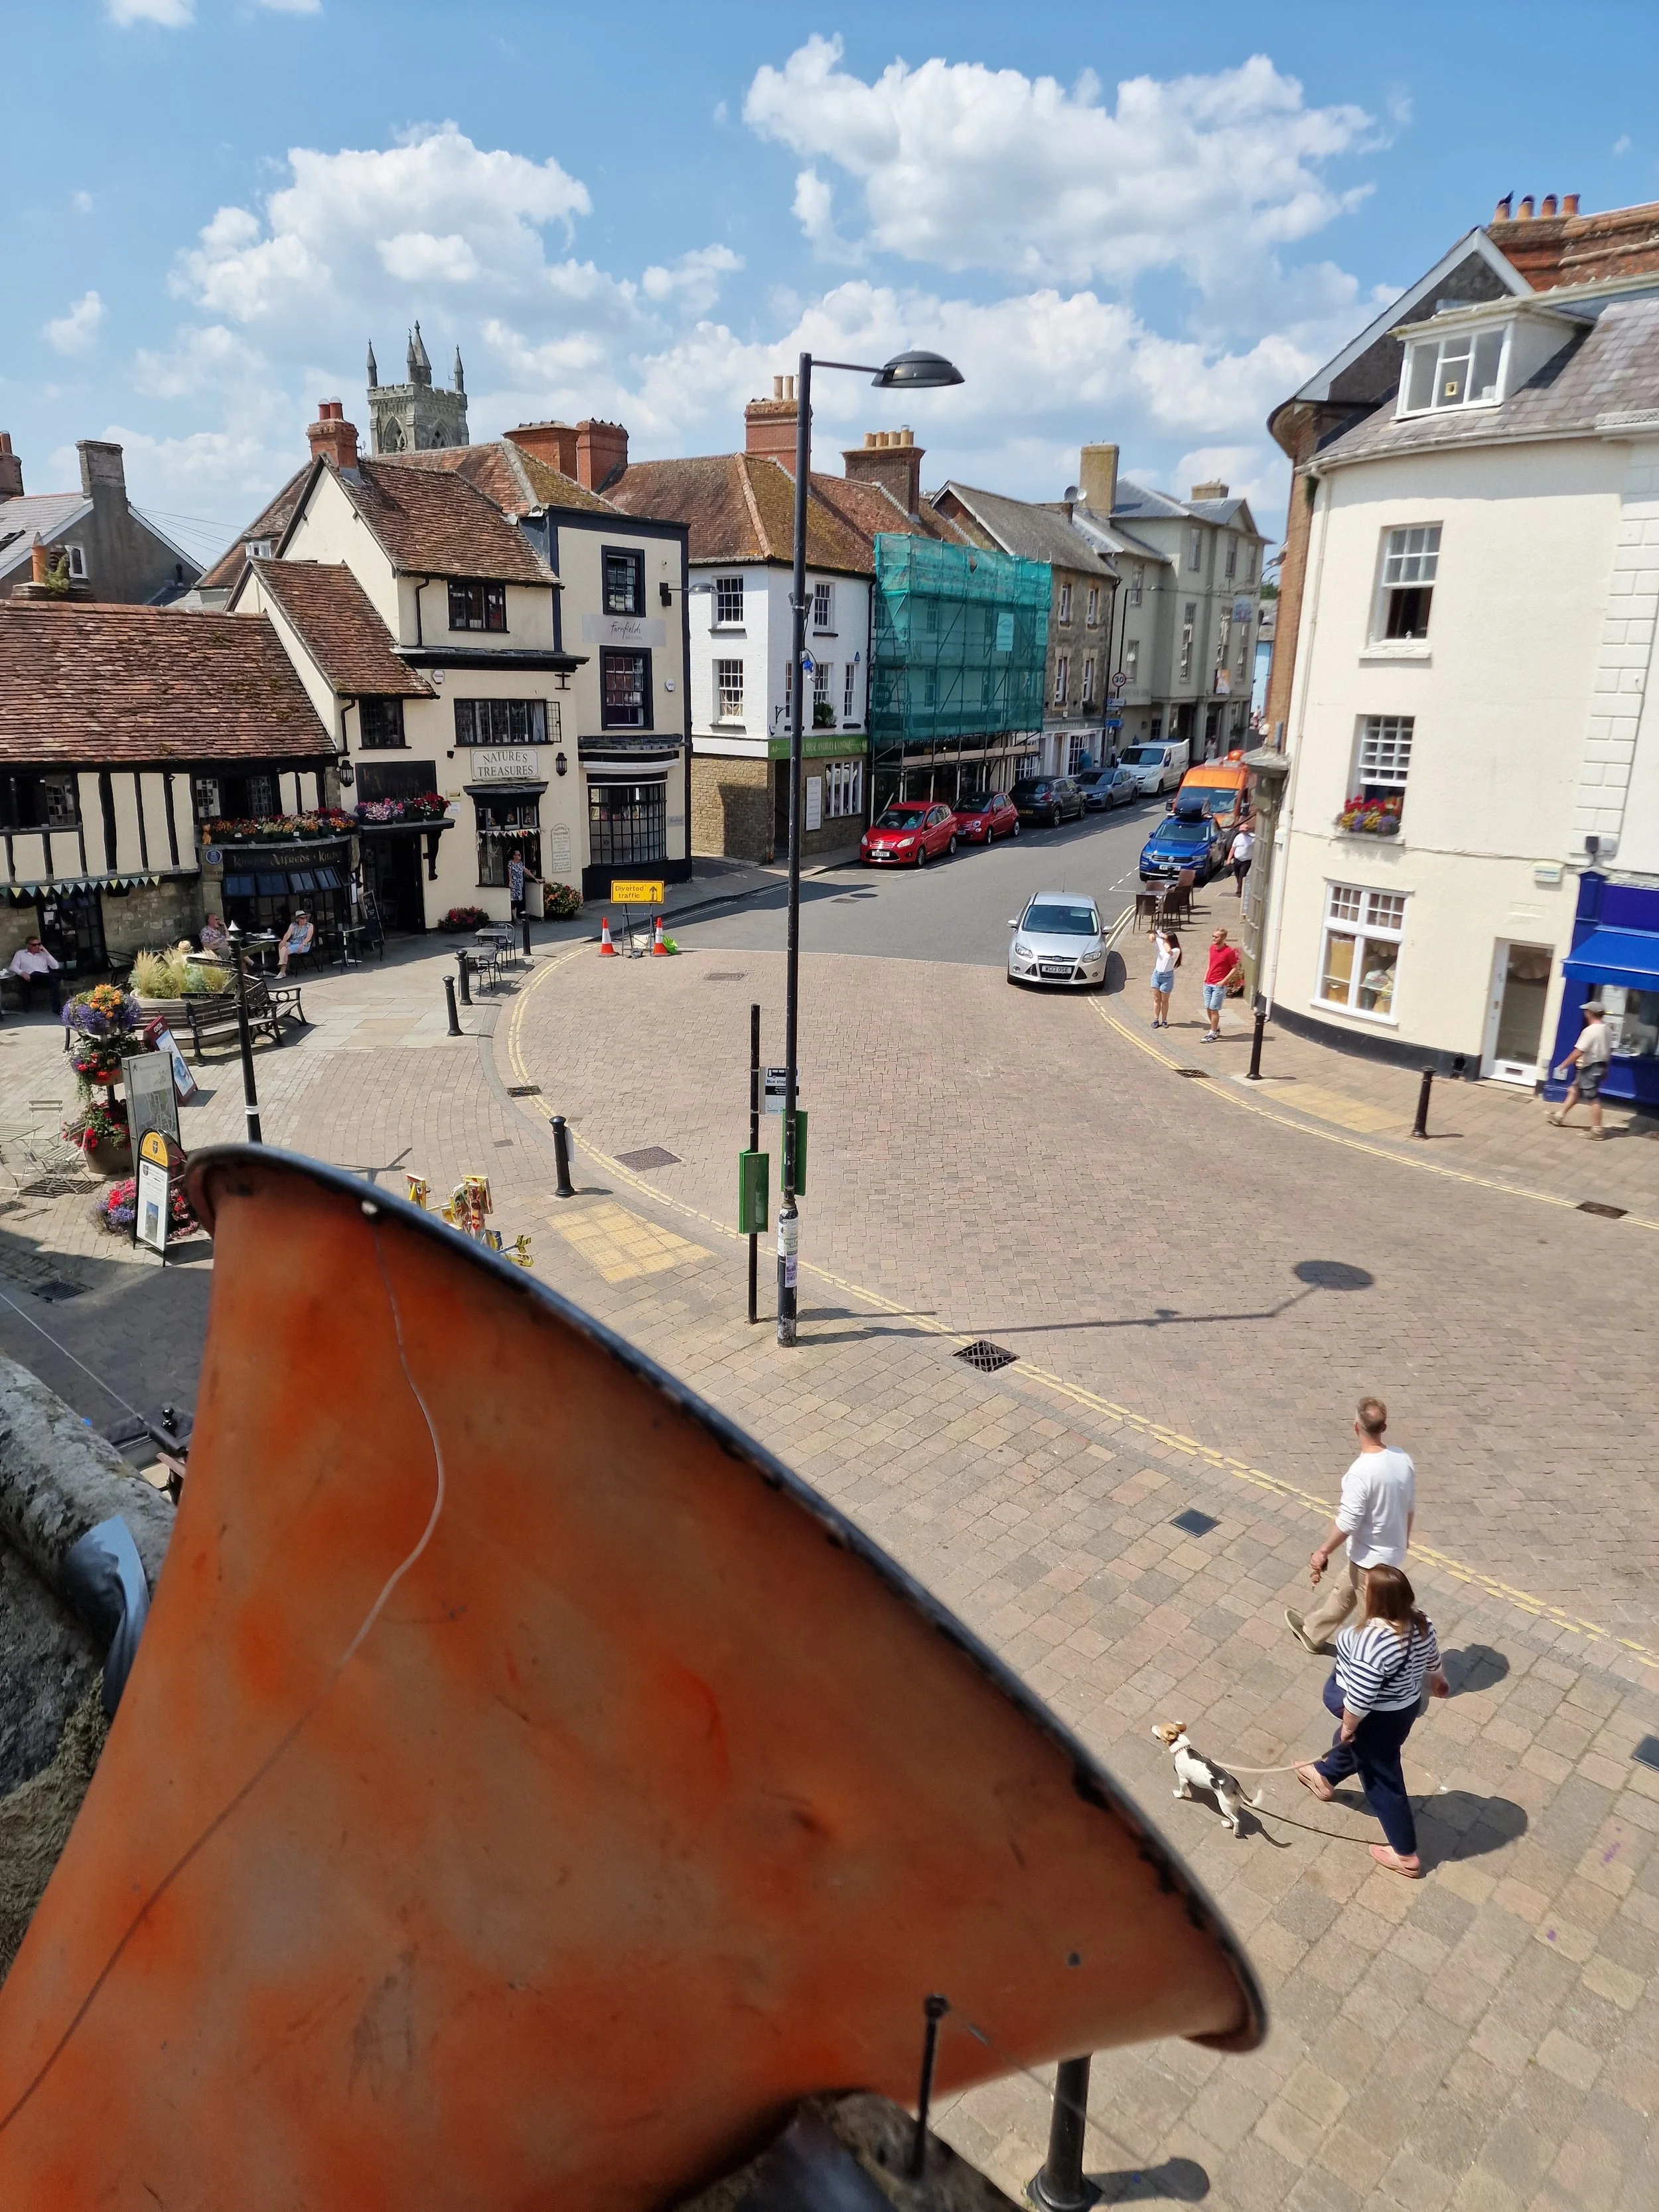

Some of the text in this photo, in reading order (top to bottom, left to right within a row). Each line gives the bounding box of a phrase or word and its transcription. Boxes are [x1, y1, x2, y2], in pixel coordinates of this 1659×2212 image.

[611, 621, 642, 639] Farnfields
[482, 751, 528, 765] NATURE'S
[478, 765, 534, 777] TREASURES
